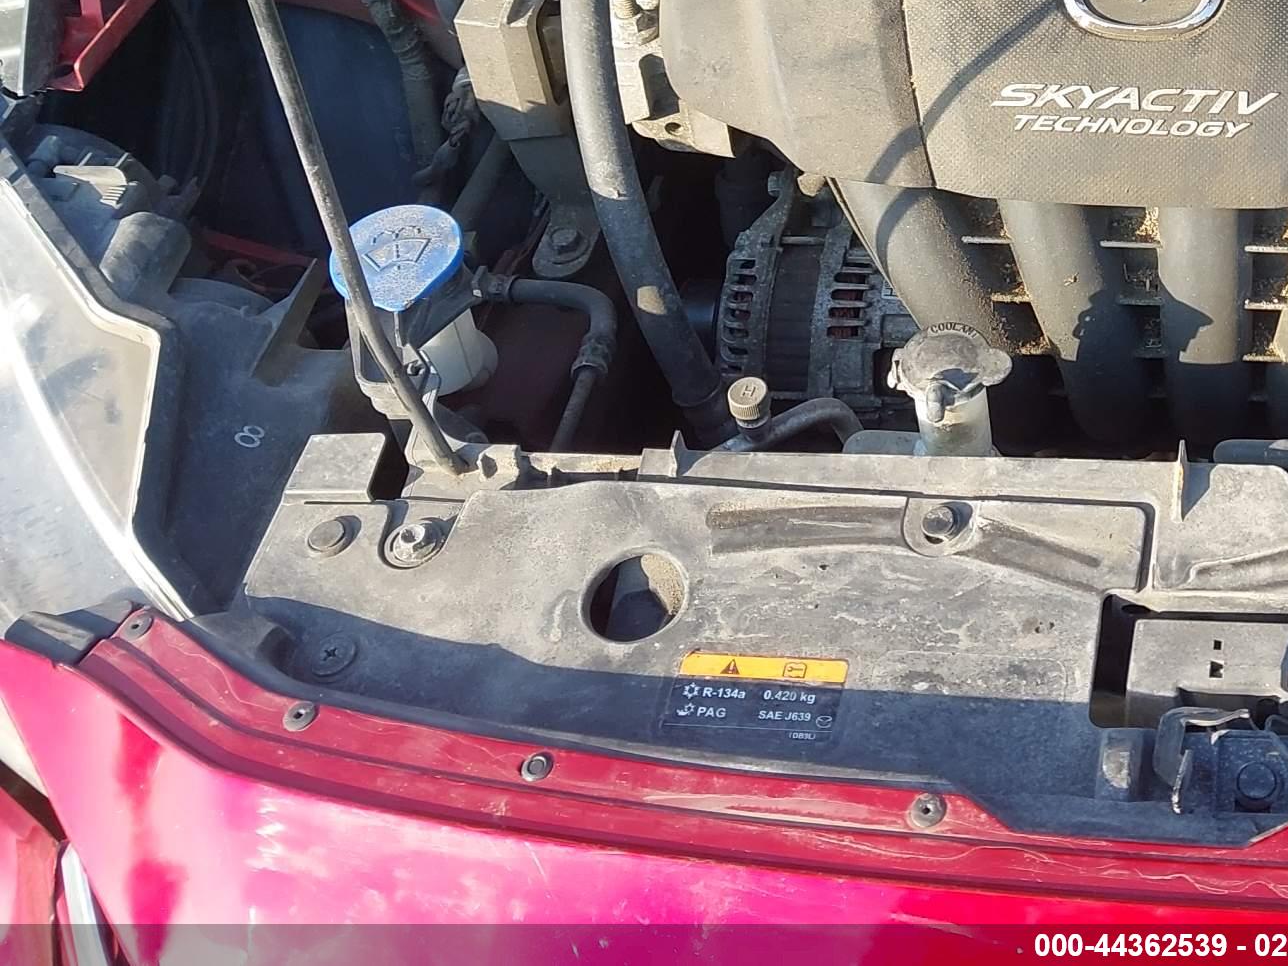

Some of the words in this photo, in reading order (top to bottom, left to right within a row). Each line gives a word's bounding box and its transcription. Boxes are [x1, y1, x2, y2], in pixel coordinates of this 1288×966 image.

[990, 84, 1280, 115] SKYACTIV
[1013, 114, 1252, 138] TECHNOLOGY
[742, 385, 757, 397] H
[702, 687, 747, 700] R-134a
[763, 689, 797, 701] 0.420
[800, 691, 816, 705] kg
[696, 706, 727, 718] PAG
[758, 710, 783, 720] SAE
[784, 712, 812, 722] J639
